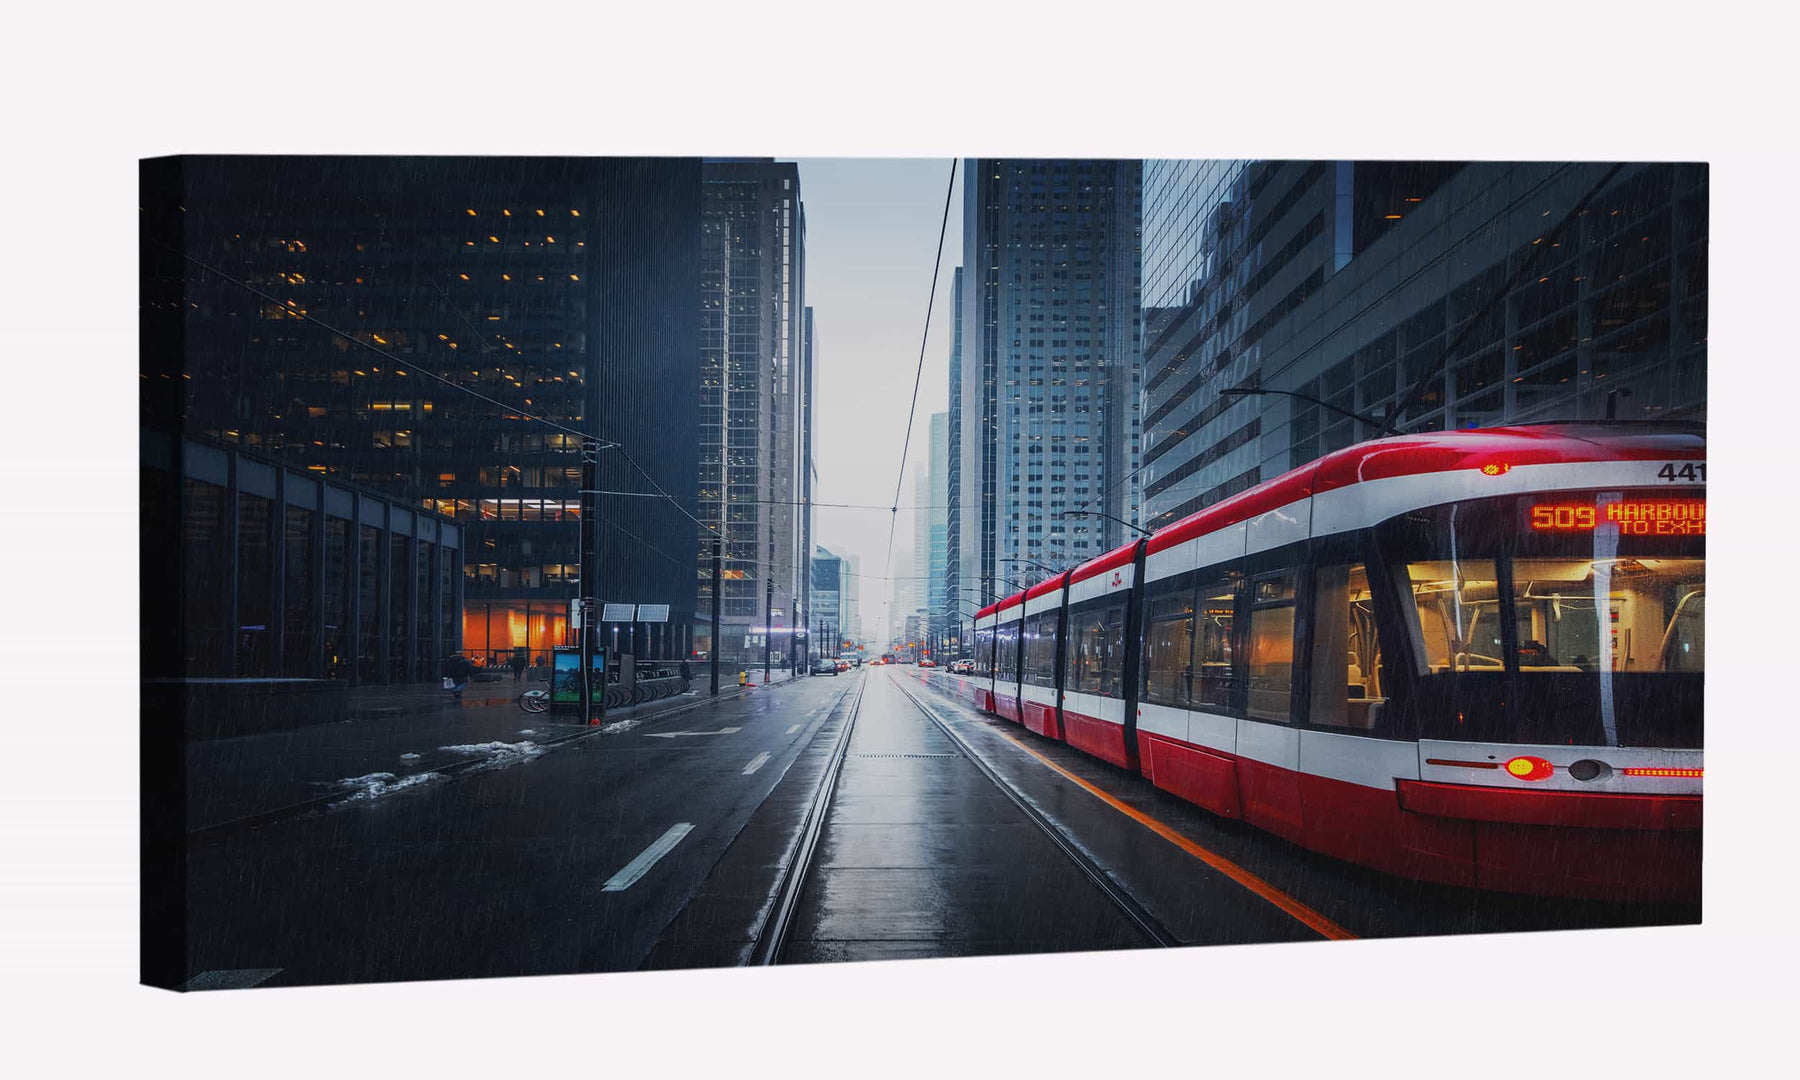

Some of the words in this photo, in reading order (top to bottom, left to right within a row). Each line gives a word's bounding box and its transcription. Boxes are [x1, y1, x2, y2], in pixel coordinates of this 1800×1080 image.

[1533, 506, 1596, 528] 509
[1607, 503, 1705, 520] HARBOU
[1619, 520, 1649, 534] TO
